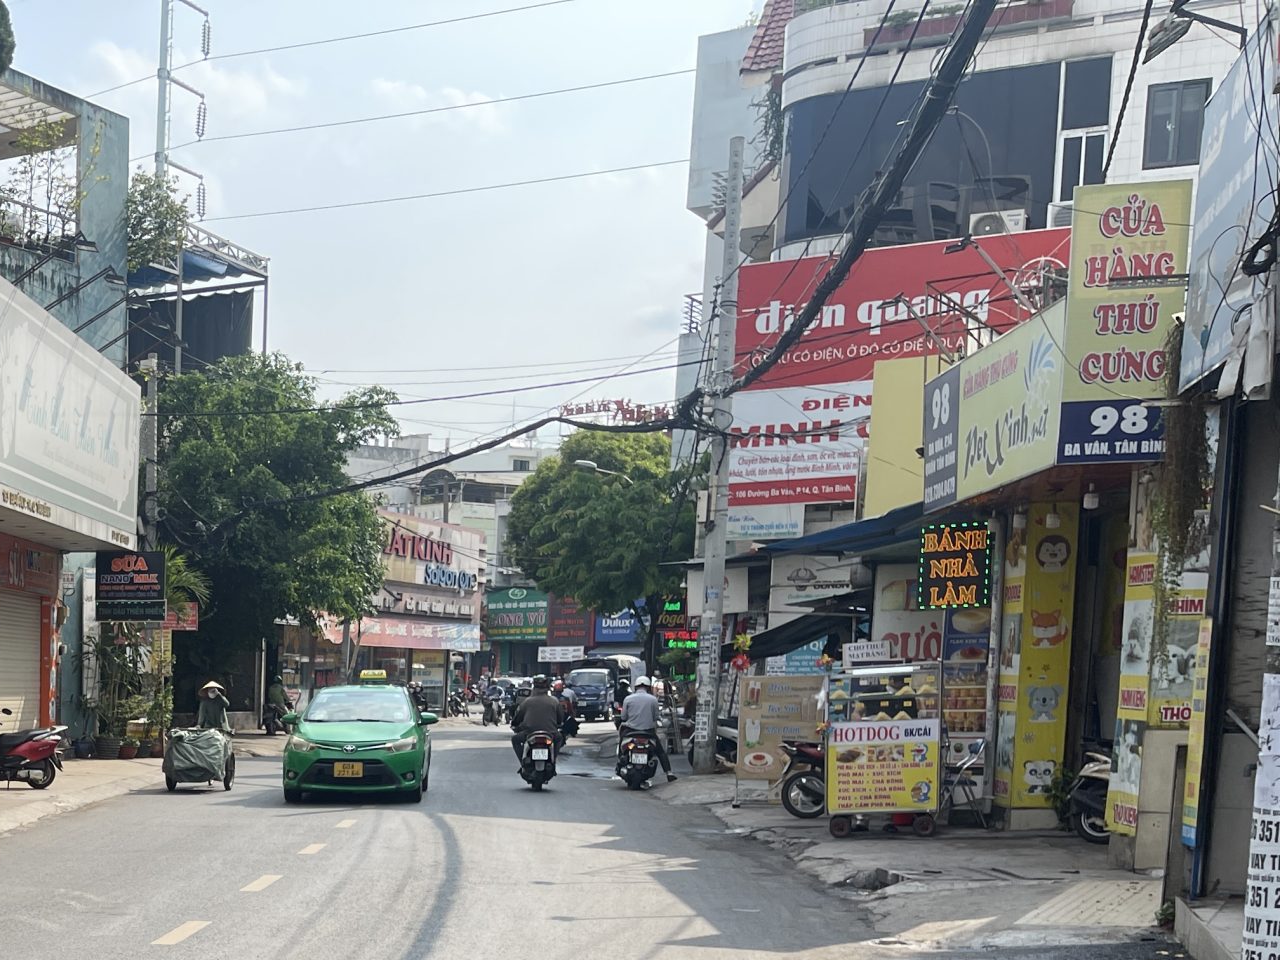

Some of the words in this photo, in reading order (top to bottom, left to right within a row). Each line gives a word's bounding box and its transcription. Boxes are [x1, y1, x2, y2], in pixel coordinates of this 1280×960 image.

[1099, 193, 1165, 238] CỬA
[1085, 247, 1175, 287] HÀNG
[856, 288, 991, 335] quang
[1094, 294, 1160, 335] THÚ
[794, 348, 811, 363] CÓ
[813, 345, 844, 361] ĐIỆN,
[847, 343, 858, 356] Ở
[860, 341, 877, 355] ĐÓ
[882, 338, 901, 353] CÓ
[1079, 346, 1167, 384] CƯNG
[801, 393, 872, 412] ĐIỆN
[932, 383, 950, 430] 98
[1090, 404, 1149, 435] 98
[730, 419, 841, 449] MINH
[1064, 443, 1081, 456] BA
[1084, 440, 1111, 455] VÂN,
[1114, 439, 1138, 454] TÂN
[747, 489, 769, 498] Đường
[771, 488, 780, 496] Ba
[821, 485, 834, 493] Tân
[383, 519, 411, 558] ẮT
[410, 531, 453, 565] KÍNH
[924, 527, 987, 552] BÁNH
[111, 555, 148, 572] SỮA
[424, 563, 458, 588] Saigon
[930, 552, 979, 578] NHÀ
[1128, 563, 1154, 586] HAMSTER
[133, 573, 159, 583] MILK
[930, 581, 977, 606] LÀM
[527, 609, 546, 626] VŨ
[1170, 597, 1204, 616] HÍM
[602, 618, 630, 628] Dulux
[1161, 702, 1190, 721] THỎ
[834, 726, 899, 742] HOTDOG
[1259, 819, 1280, 843] 351
[1251, 853, 1266, 870] VAY
[1250, 885, 1268, 908] 351
[1245, 916, 1261, 934] VAY
